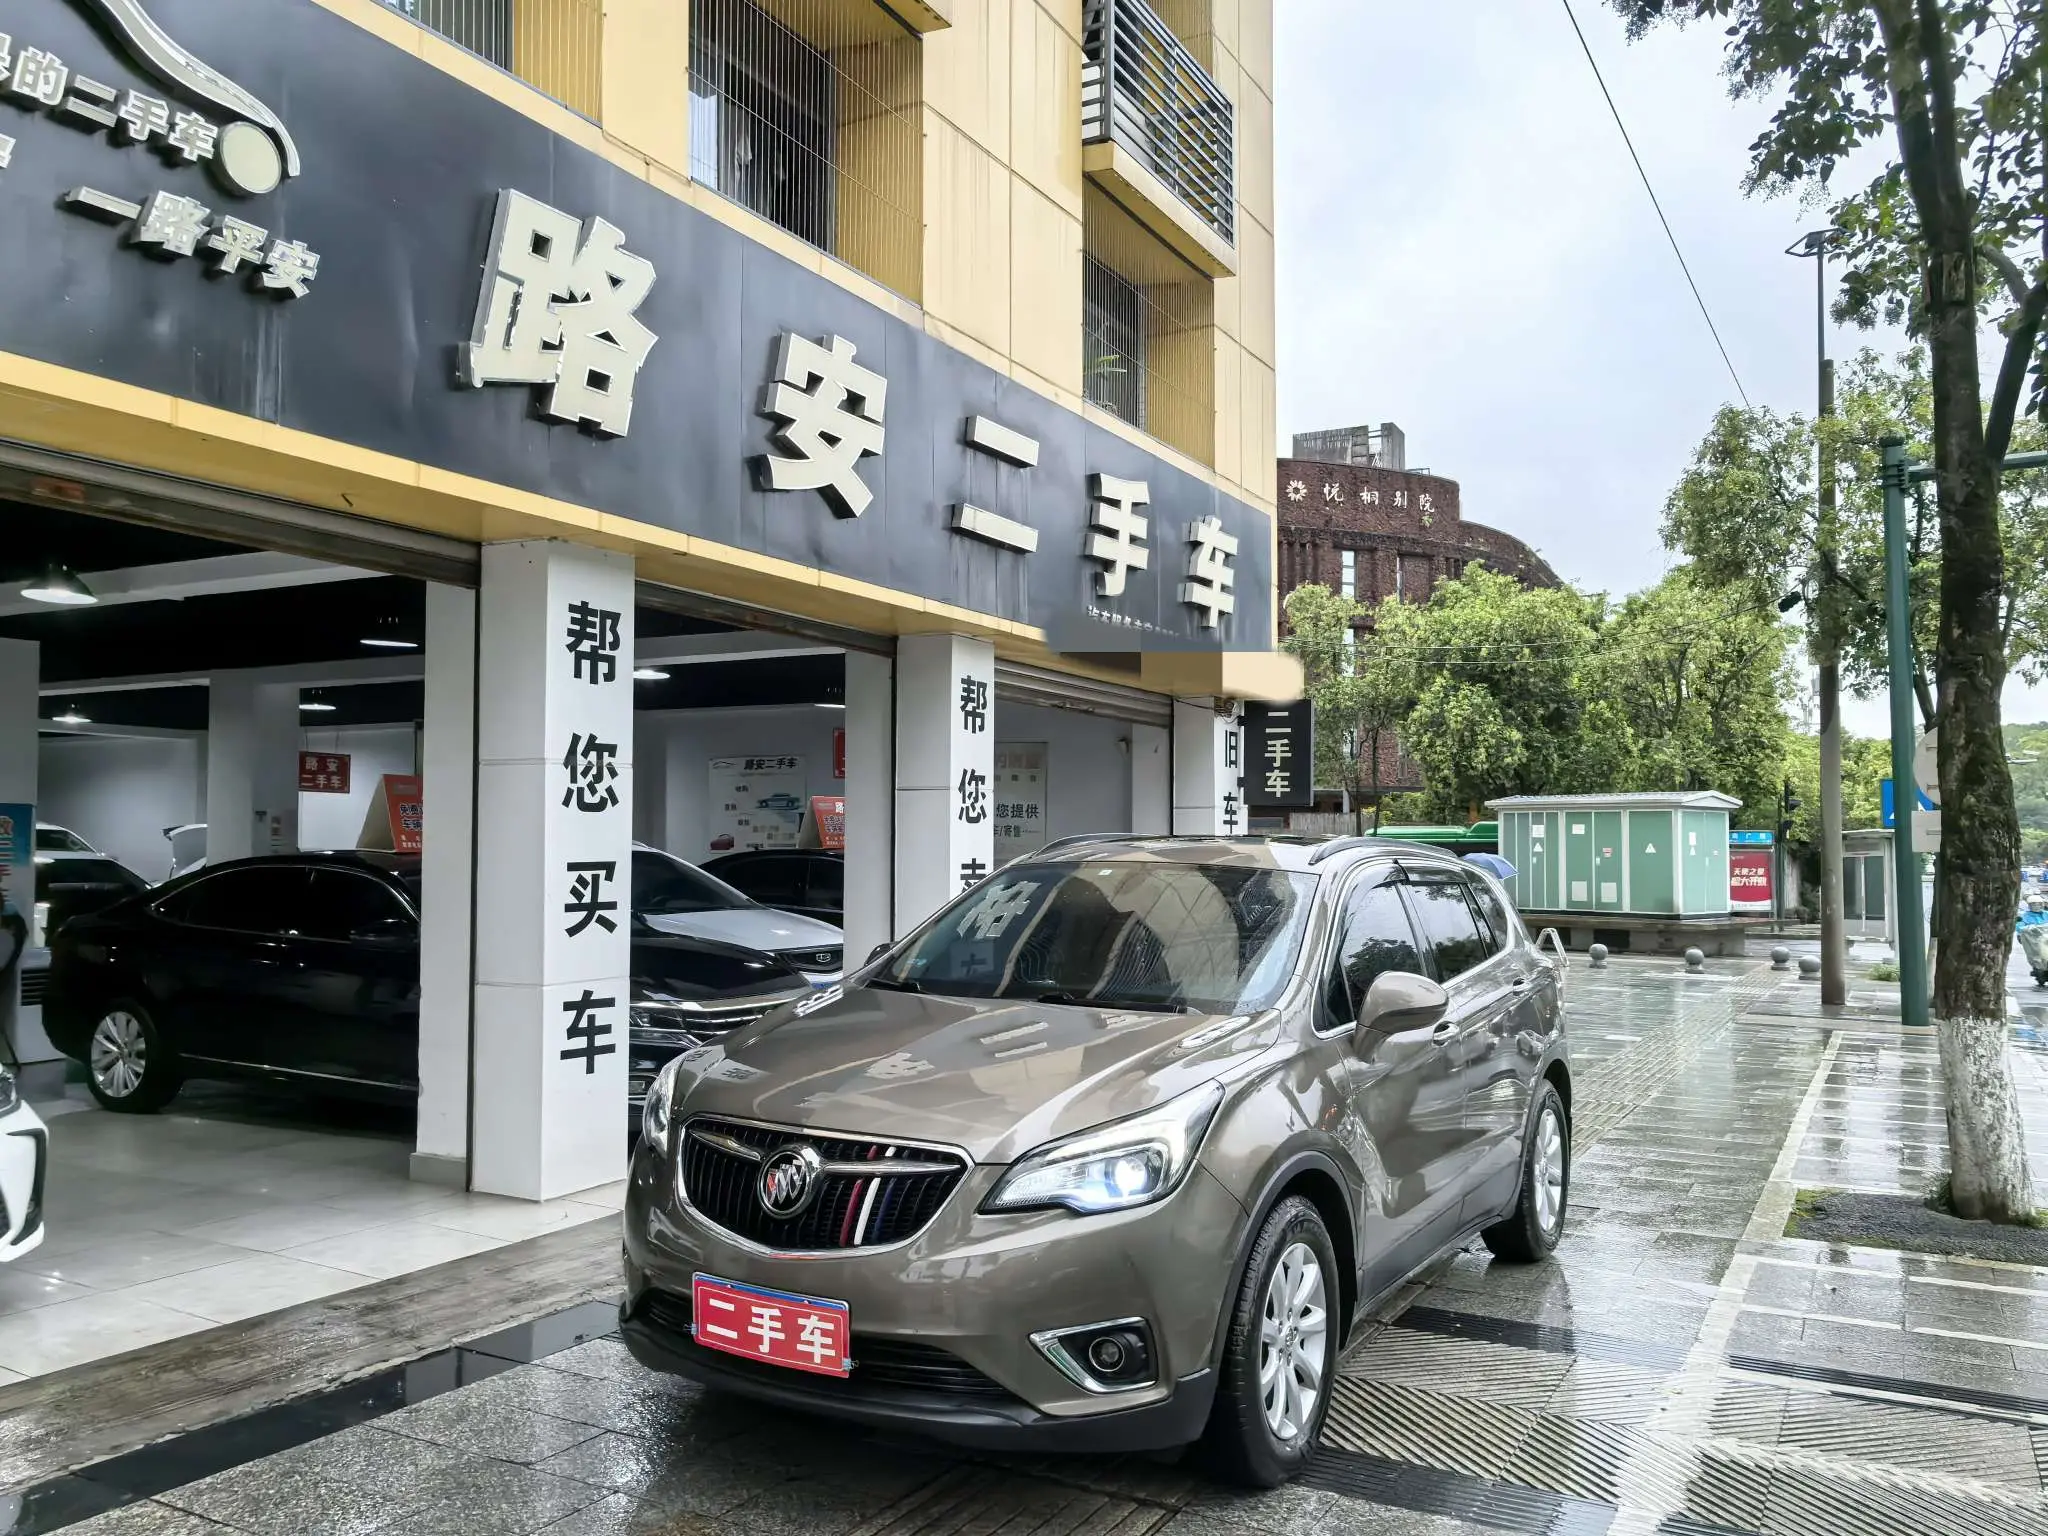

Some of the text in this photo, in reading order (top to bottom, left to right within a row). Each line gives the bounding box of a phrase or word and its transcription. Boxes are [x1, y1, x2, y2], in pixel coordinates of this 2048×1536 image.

[0, 31, 218, 162] 的二手车
[66, 186, 320, 298] 一路平安
[457, 188, 1238, 628] 路安二手车
[301, 774, 344, 789] 二手车
[1264, 711, 1292, 798] 二手车
[559, 600, 621, 1075] 帮您买车
[996, 803, 1039, 819] 您提供
[707, 1298, 836, 1364] 二手车
